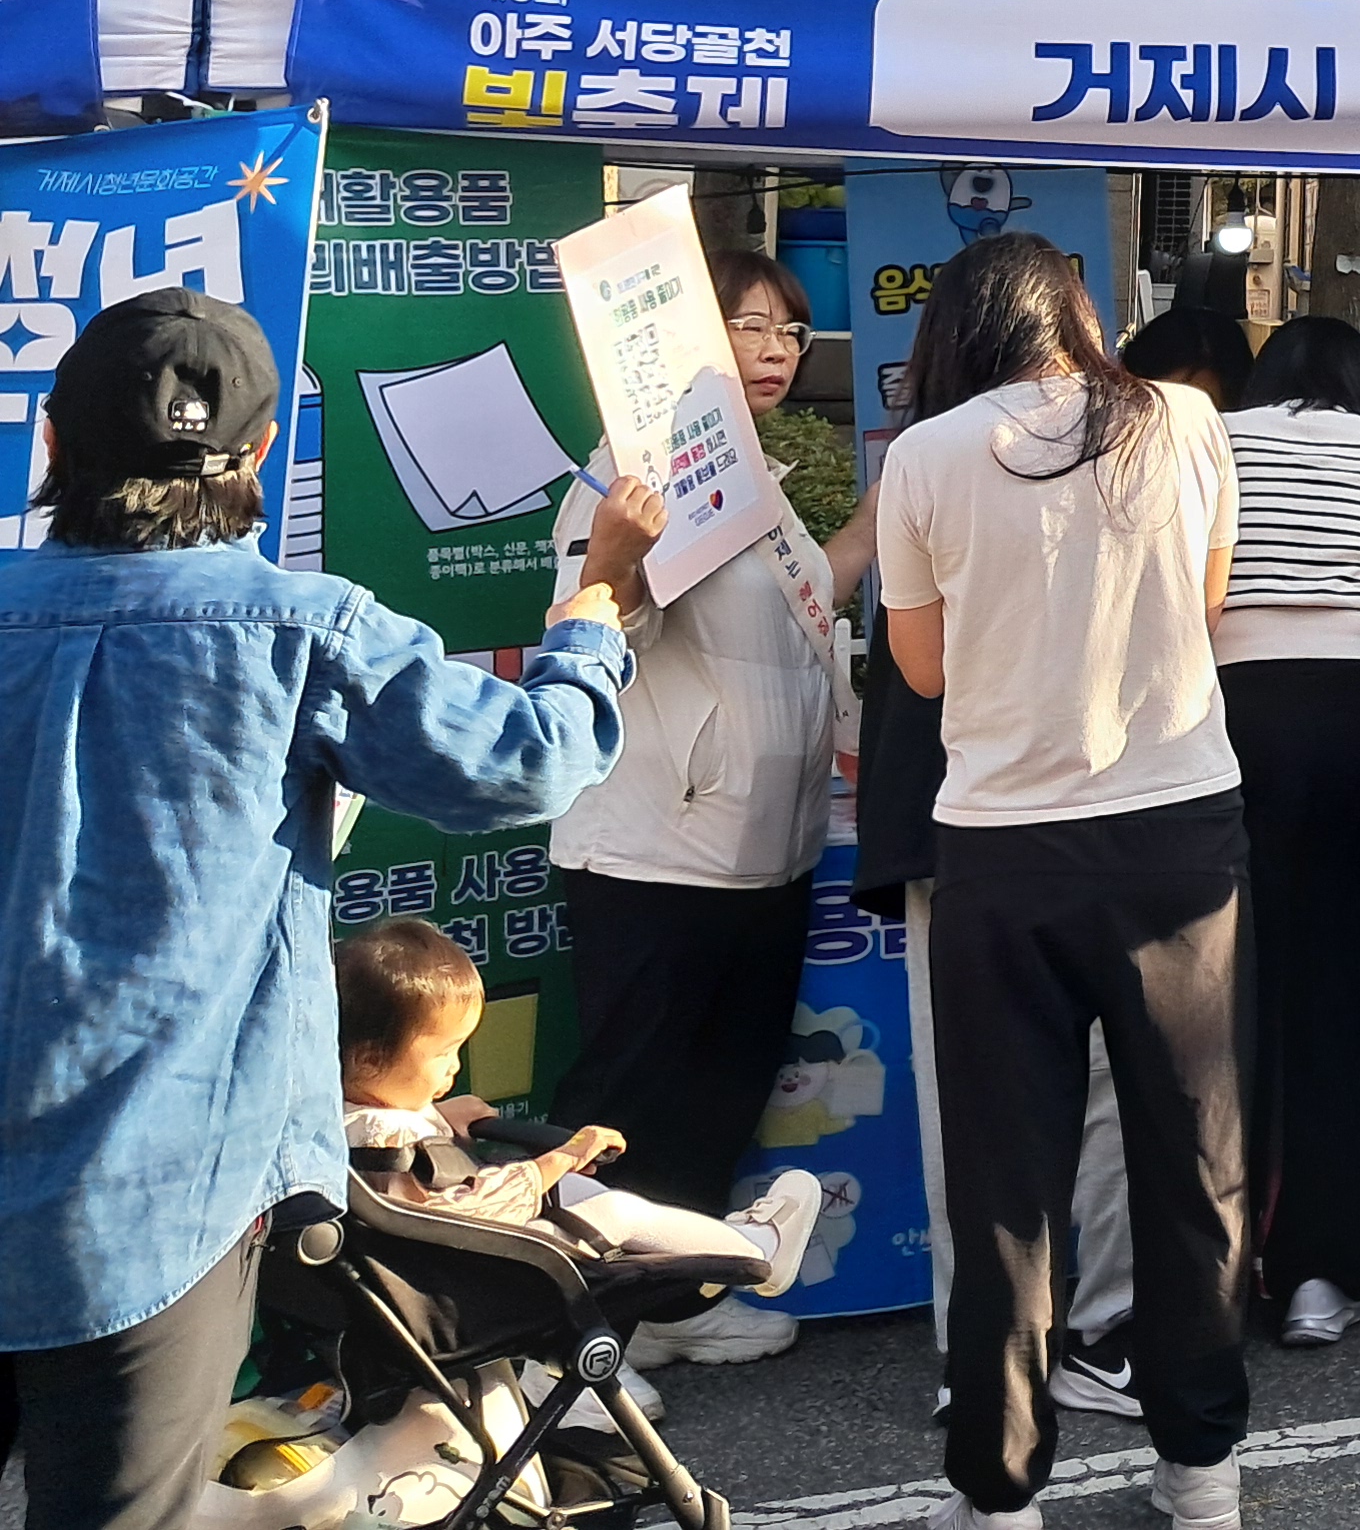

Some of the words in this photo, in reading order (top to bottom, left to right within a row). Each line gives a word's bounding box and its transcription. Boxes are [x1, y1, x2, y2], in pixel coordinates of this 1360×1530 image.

[468, 12, 574, 62] 아주
[585, 19, 793, 68] 서당골천
[1031, 40, 1338, 124] 거제시
[37, 165, 219, 196] 거제시청년문화공간
[451, 845, 549, 904] 사용
